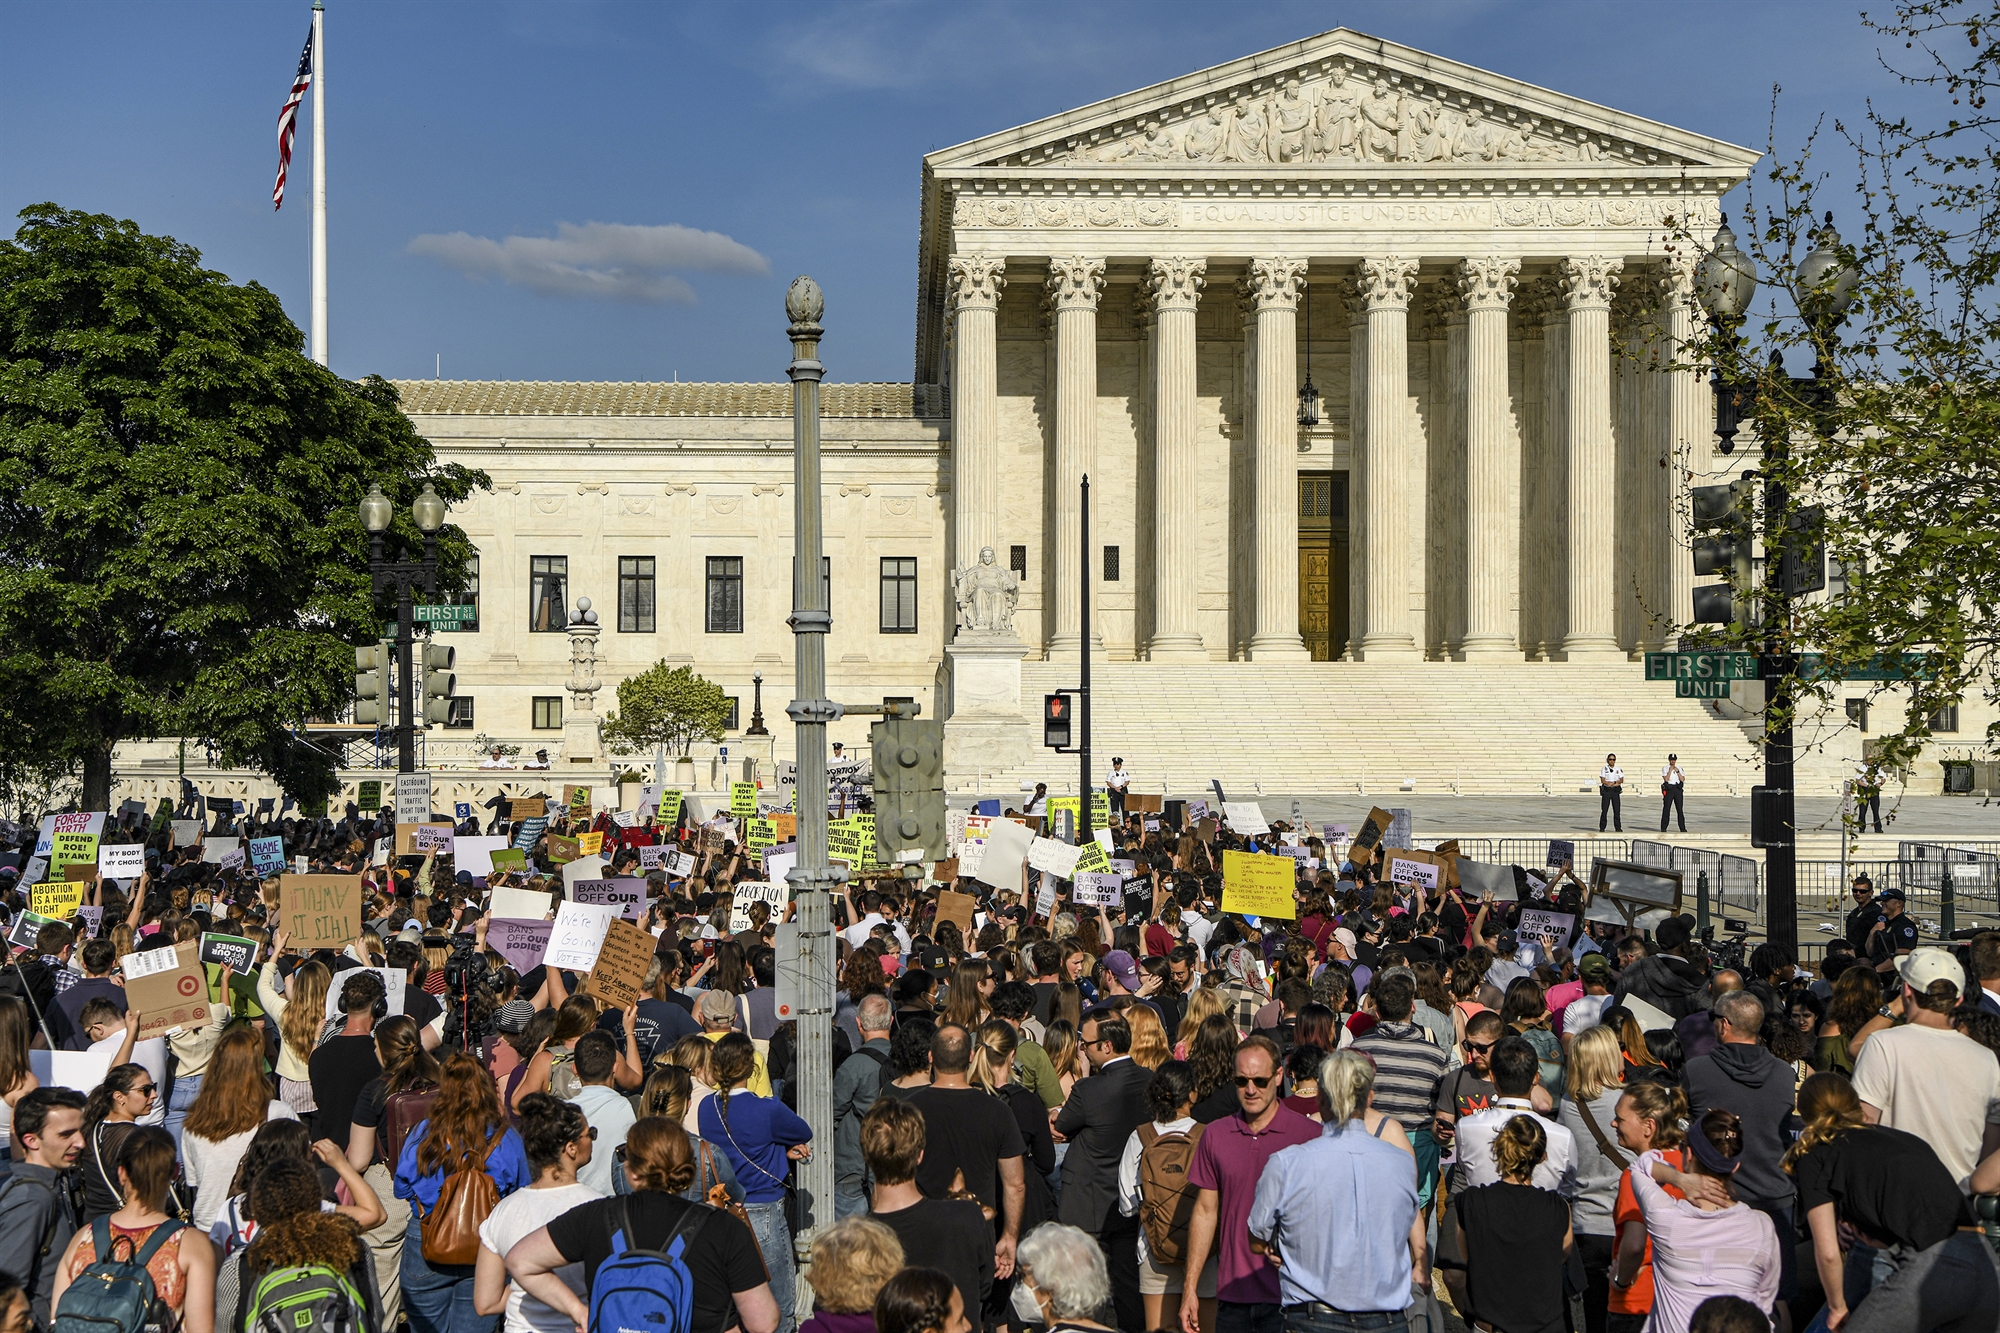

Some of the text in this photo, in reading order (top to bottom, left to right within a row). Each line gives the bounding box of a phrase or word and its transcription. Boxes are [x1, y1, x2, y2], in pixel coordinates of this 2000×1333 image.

[1193, 205, 1480, 222] EQUAL JUSTICE UNDER LAW
[418, 607, 461, 620] FIRST
[432, 621, 457, 630] UNIT
[1650, 655, 1750, 679] FIRST ST
[1735, 667, 1753, 678] NE
[1679, 682, 1727, 697] UNIT
[1049, 800, 1071, 808] Squish
[54, 813, 92, 827] FORCED
[847, 829, 860, 838] THE
[251, 840, 280, 854] SHAME
[843, 846, 858, 855] WON
[1085, 843, 1099, 852] THE
[1551, 843, 1567, 851] BANS
[764, 849, 786, 857] BANS
[221, 854, 236, 864] BANS
[233, 856, 244, 865] OUR
[1075, 860, 1089, 871] HAS
[1088, 856, 1104, 867] WON
[253, 860, 284, 874] SCOTUS
[1394, 861, 1418, 870] BANS
[1394, 868, 1433, 880] OFF OUR
[1078, 875, 1102, 885] BANS
[1124, 878, 1147, 890] ABORTION
[33, 884, 73, 895] ABORTION
[578, 884, 614, 892] BANS
[1077, 884, 1117, 894] OFF OUR
[1125, 885, 1143, 895] JUSTICE
[34, 894, 77, 904] IS A HUMAN
[578, 893, 639, 903] OFF OUR
[736, 886, 784, 902] ABORTION
[1076, 893, 1111, 902] BODIES
[34, 904, 59, 914] RIGHT
[78, 908, 95, 917] BANS
[561, 911, 591, 928] We're
[1523, 913, 1551, 924] BANS
[292, 914, 357, 944] IS THIS
[508, 926, 534, 934] BANS
[610, 921, 621, 931] I
[732, 920, 750, 930] COST
[1522, 922, 1567, 935] OFF OUR
[507, 934, 549, 945] OFF OUR
[561, 931, 596, 953] Going
[609, 932, 631, 945] beholden
[215, 942, 247, 954] BODIES
[506, 942, 542, 952] BODIES
[605, 942, 630, 955] document
[211, 948, 246, 960] OUR OFF
[554, 954, 581, 964] VOTE
[595, 970, 613, 983] KEEP
[599, 982, 614, 993] SAFE
[141, 1022, 156, 1032] 064
[636, 1017, 660, 1030] NNUAL
